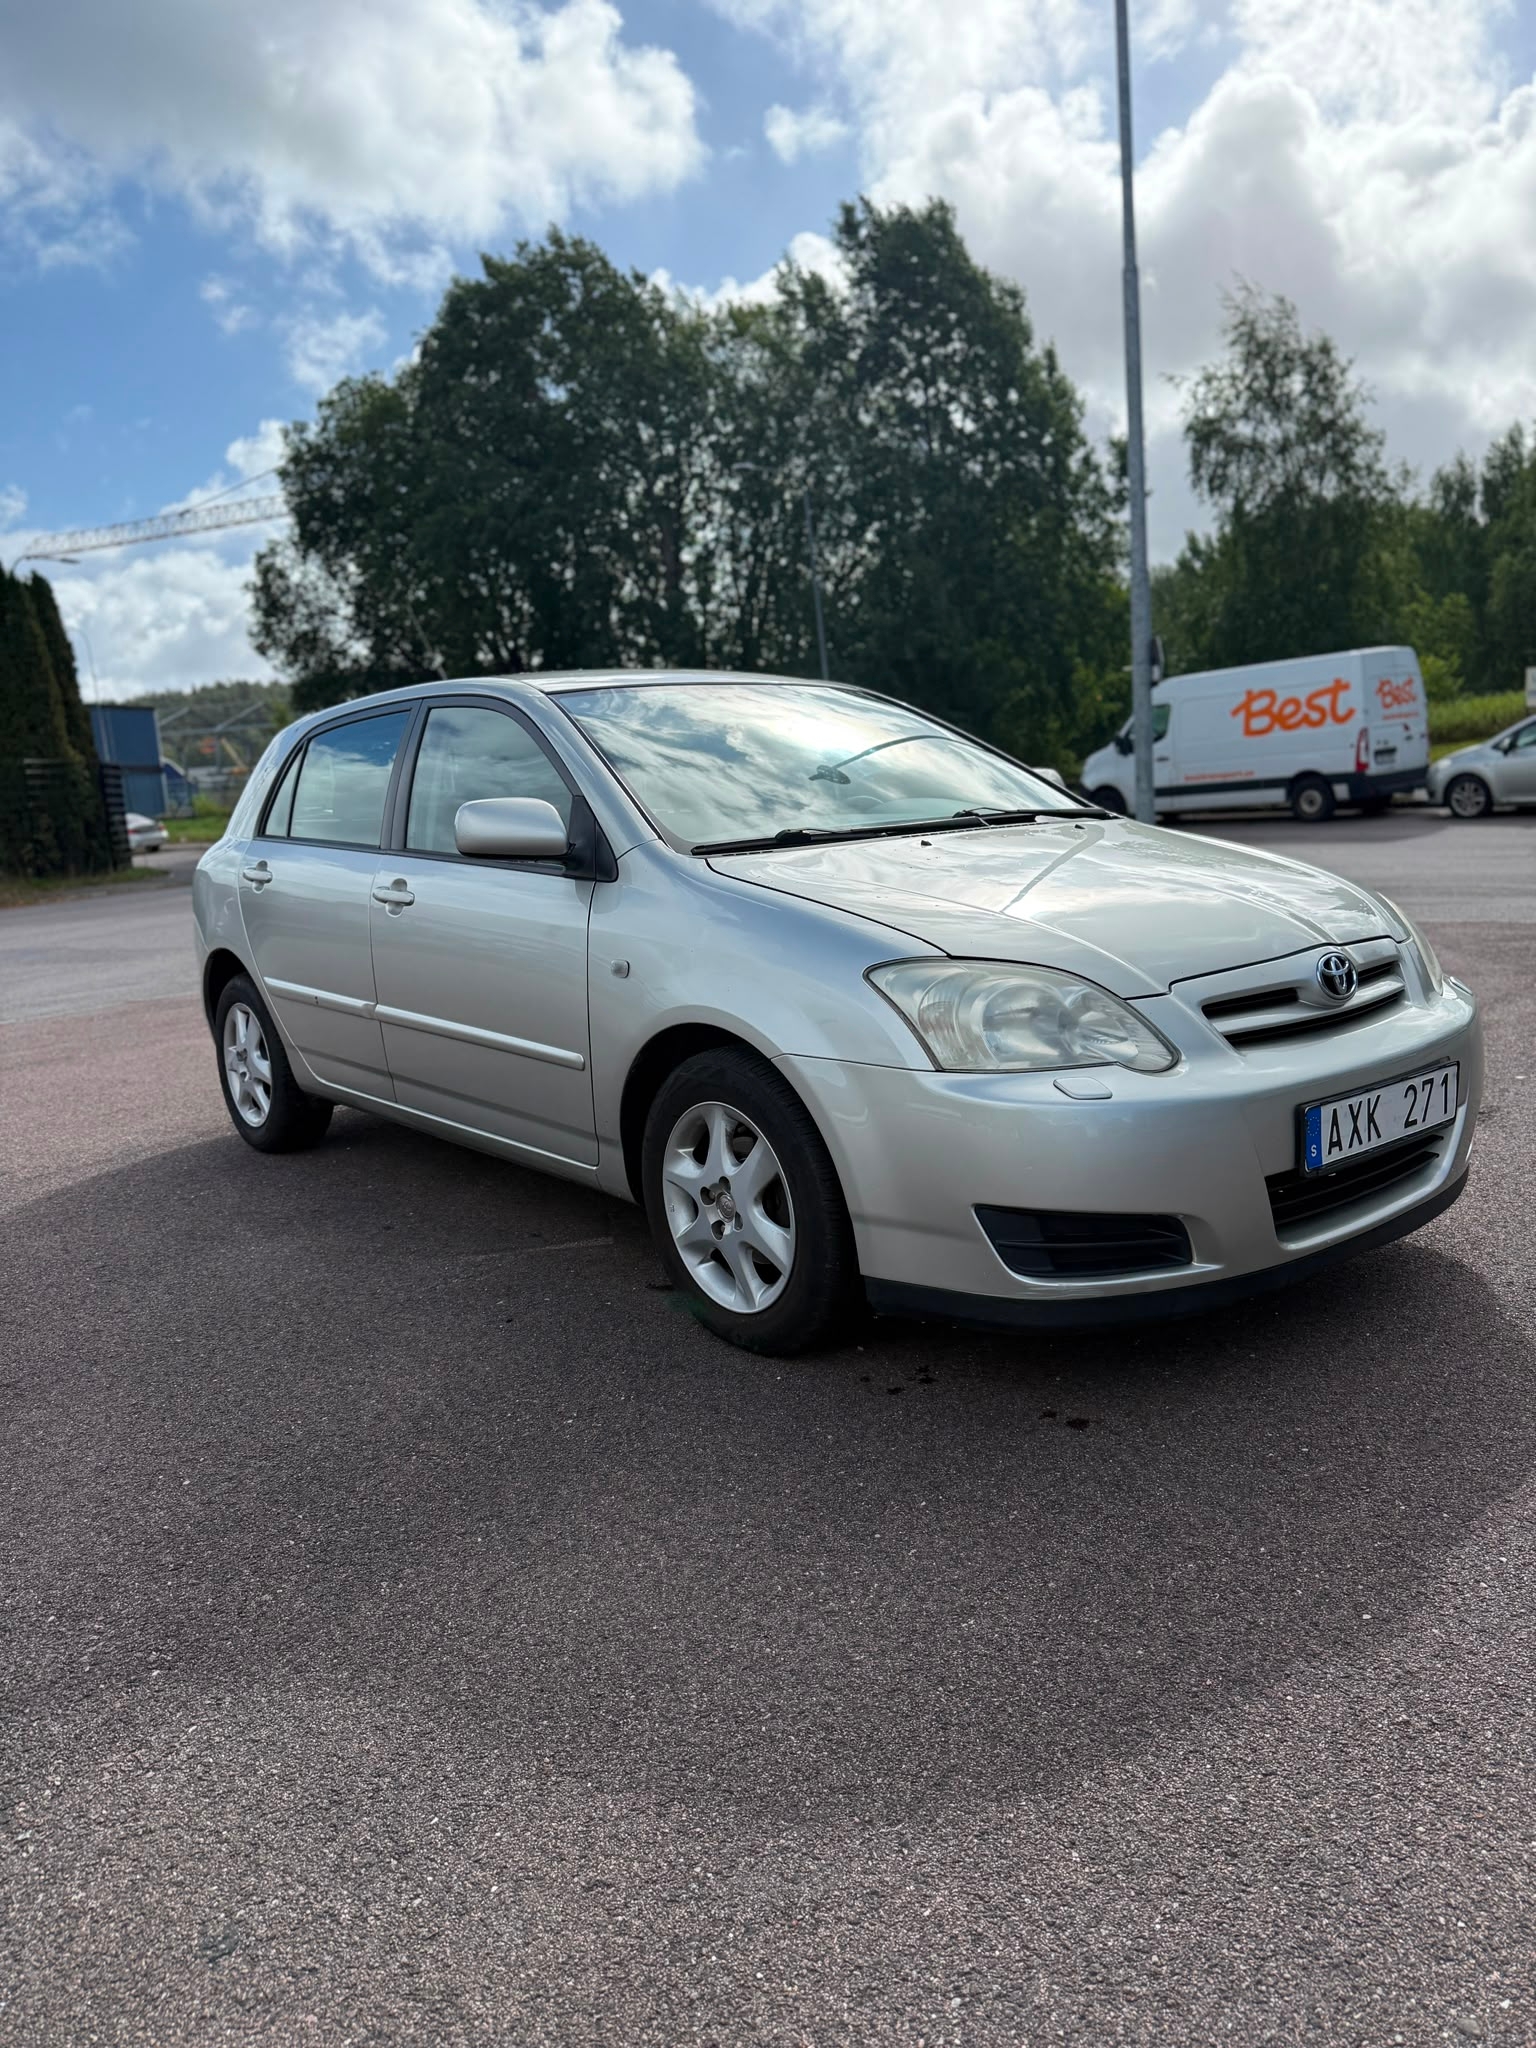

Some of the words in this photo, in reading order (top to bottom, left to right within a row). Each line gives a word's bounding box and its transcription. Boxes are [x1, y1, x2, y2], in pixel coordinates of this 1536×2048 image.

[1230, 678, 1356, 736] Best
[1375, 677, 1417, 708] Best
[1327, 1094, 1382, 1155] AXK
[1404, 1073, 1449, 1128] 271
[1311, 1144, 1317, 1157] S
